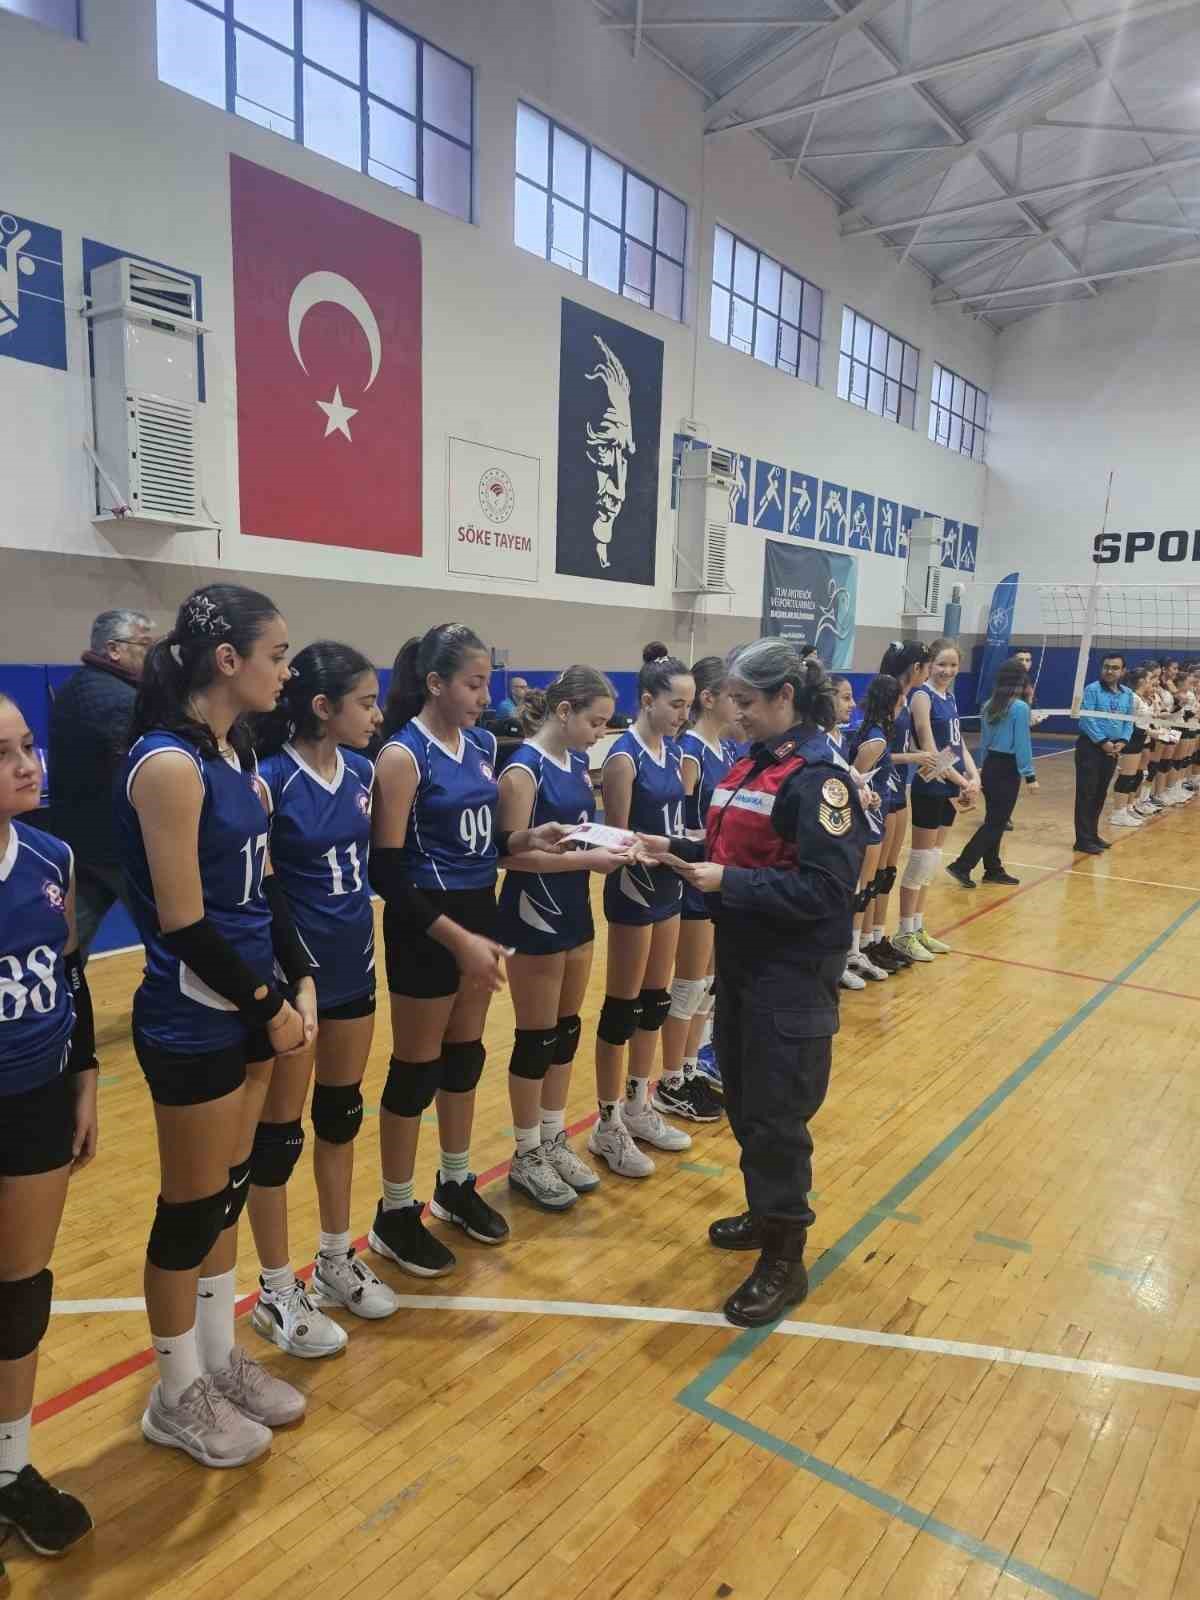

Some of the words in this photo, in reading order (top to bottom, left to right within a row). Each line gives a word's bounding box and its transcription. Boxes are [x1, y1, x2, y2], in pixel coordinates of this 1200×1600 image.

[458, 525, 491, 546] SÖKE
[493, 533, 532, 552] TAYEM
[1093, 529, 1200, 564] SPO
[949, 718, 961, 746] 18
[459, 804, 492, 857] 99
[661, 800, 686, 837] 14
[235, 831, 269, 906] 17
[321, 841, 363, 897] 11
[0, 945, 58, 1022] 88
